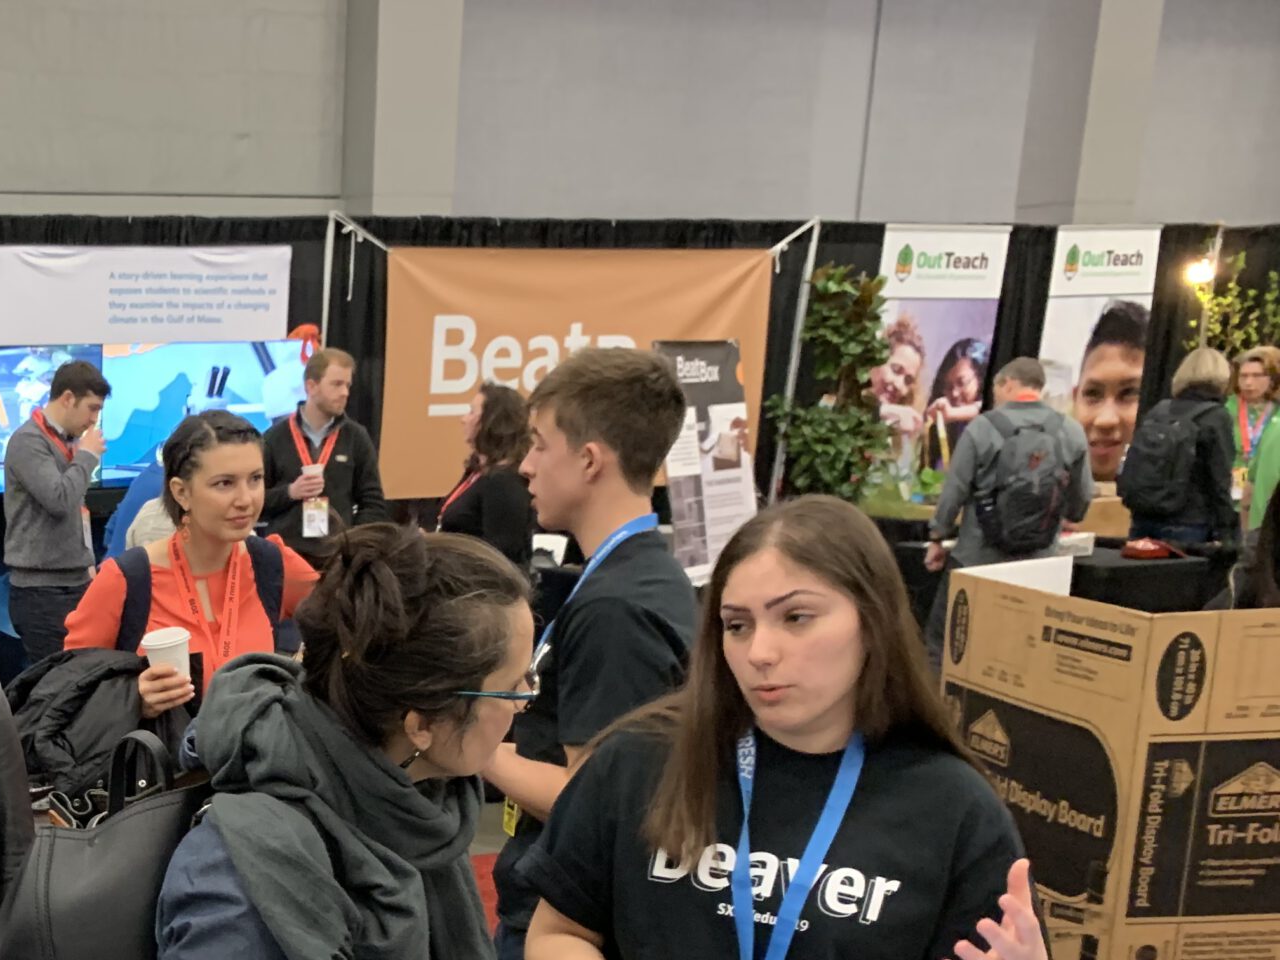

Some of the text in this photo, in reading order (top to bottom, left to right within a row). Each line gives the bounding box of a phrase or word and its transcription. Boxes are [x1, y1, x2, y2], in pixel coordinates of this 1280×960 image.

[916, 251, 989, 271] OutTeach
[1081, 250, 1143, 268] OutTeach
[737, 733, 756, 779] RESH
[1008, 780, 1059, 823] Display
[1058, 800, 1105, 838] Board
[1134, 759, 1170, 908] Tri-Fold Display Board
